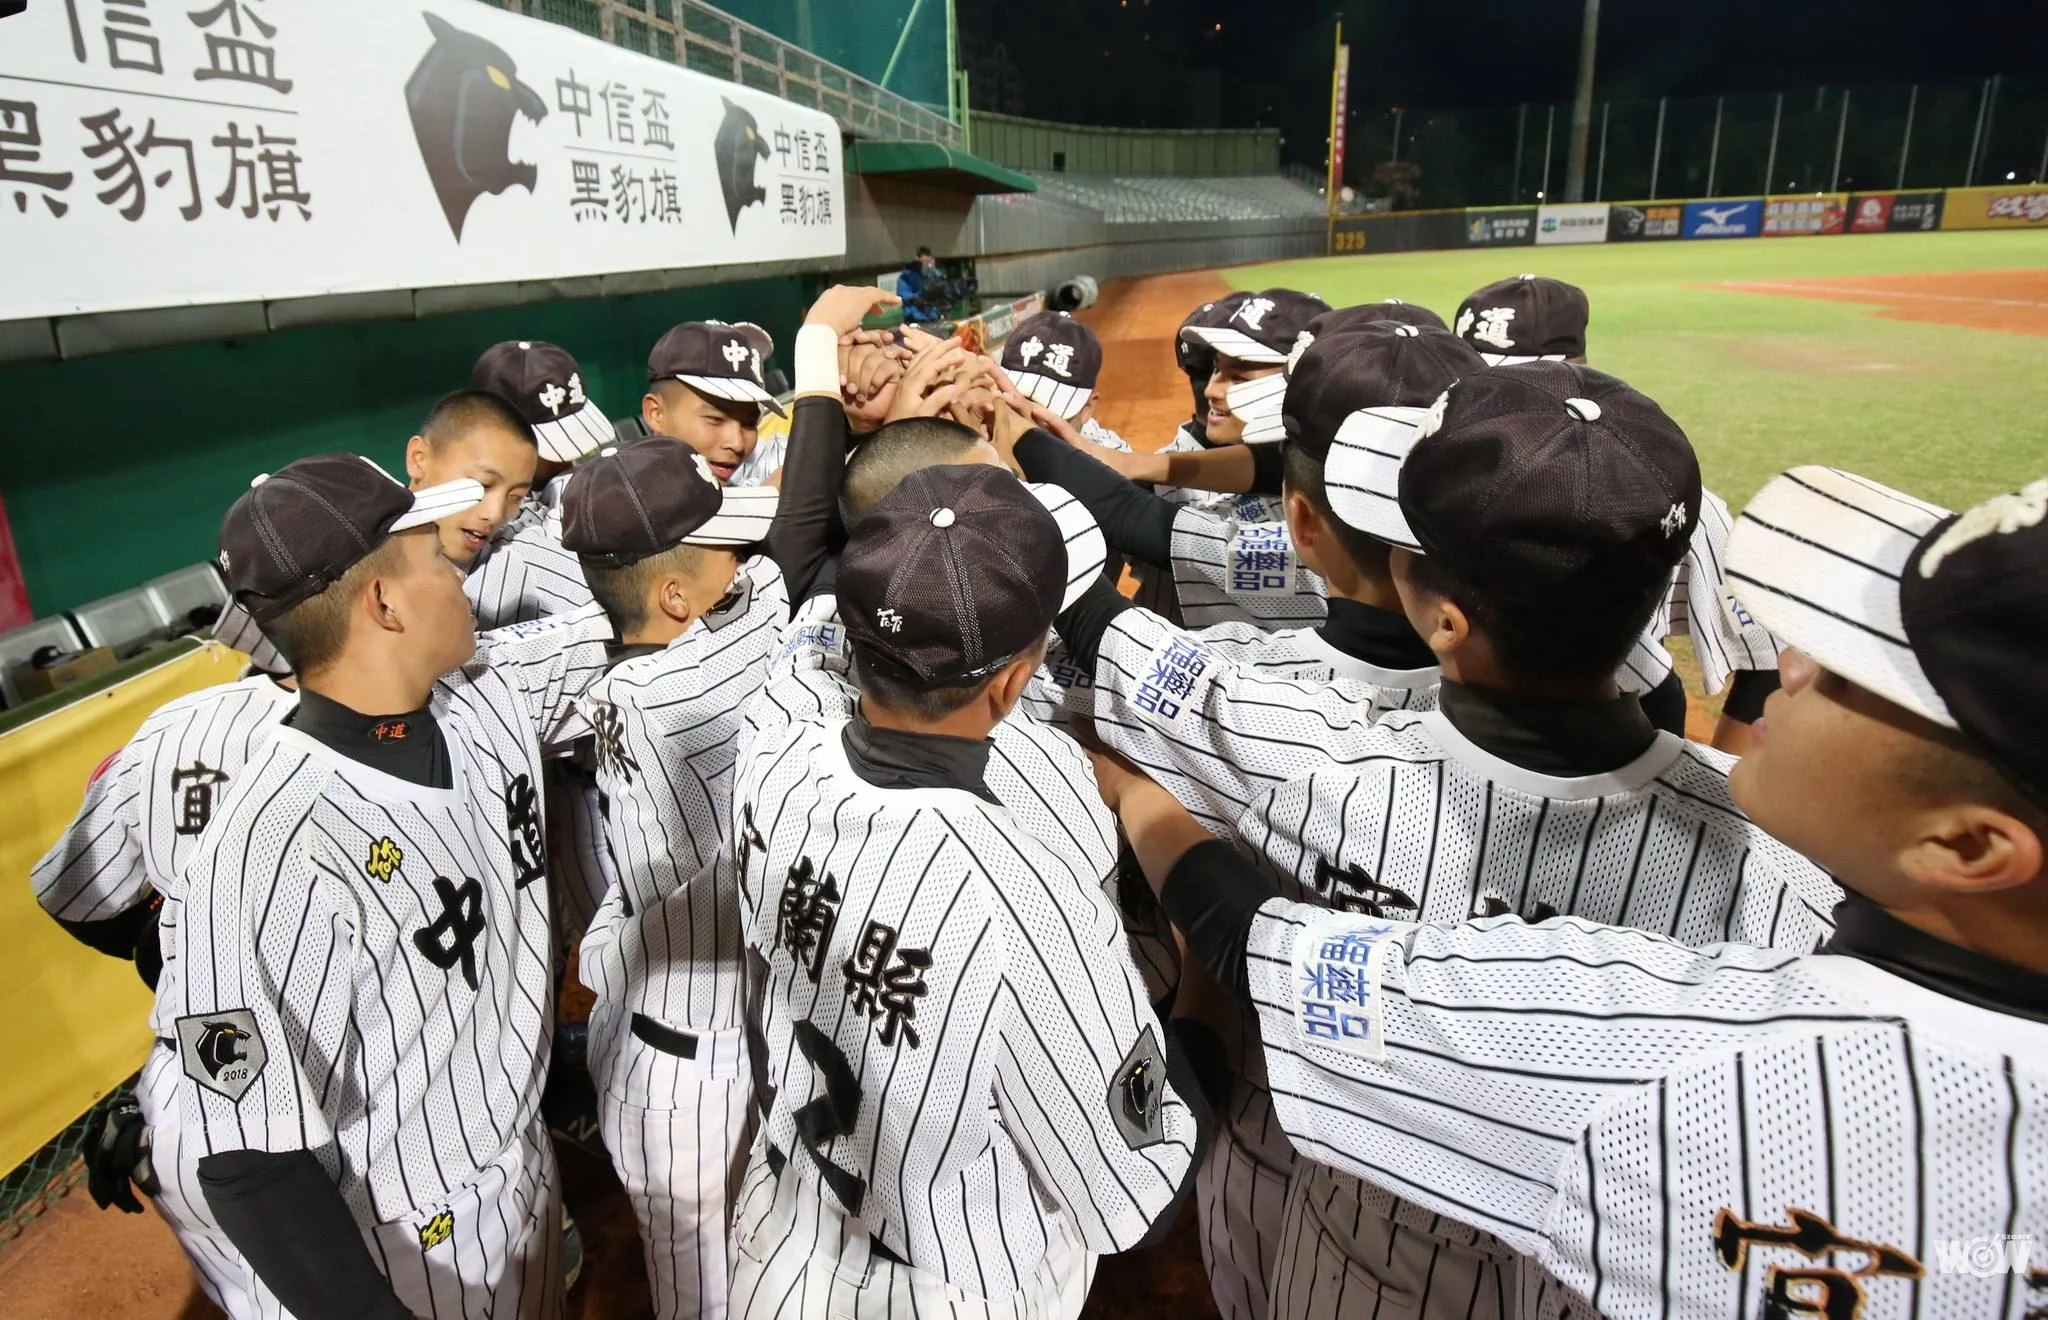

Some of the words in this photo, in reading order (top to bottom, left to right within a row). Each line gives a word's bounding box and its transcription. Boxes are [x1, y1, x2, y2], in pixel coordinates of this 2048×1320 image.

[555, 67, 675, 151] 中信盃
[774, 121, 830, 174] 中信盃
[570, 159, 682, 225] 黑豹旗
[779, 183, 832, 225] 黑豹旗
[1335, 231, 1367, 250] 325
[1020, 335, 1075, 378] 中道
[1134, 634, 1212, 720] 輝藥品
[223, 1068, 248, 1082] 2018
